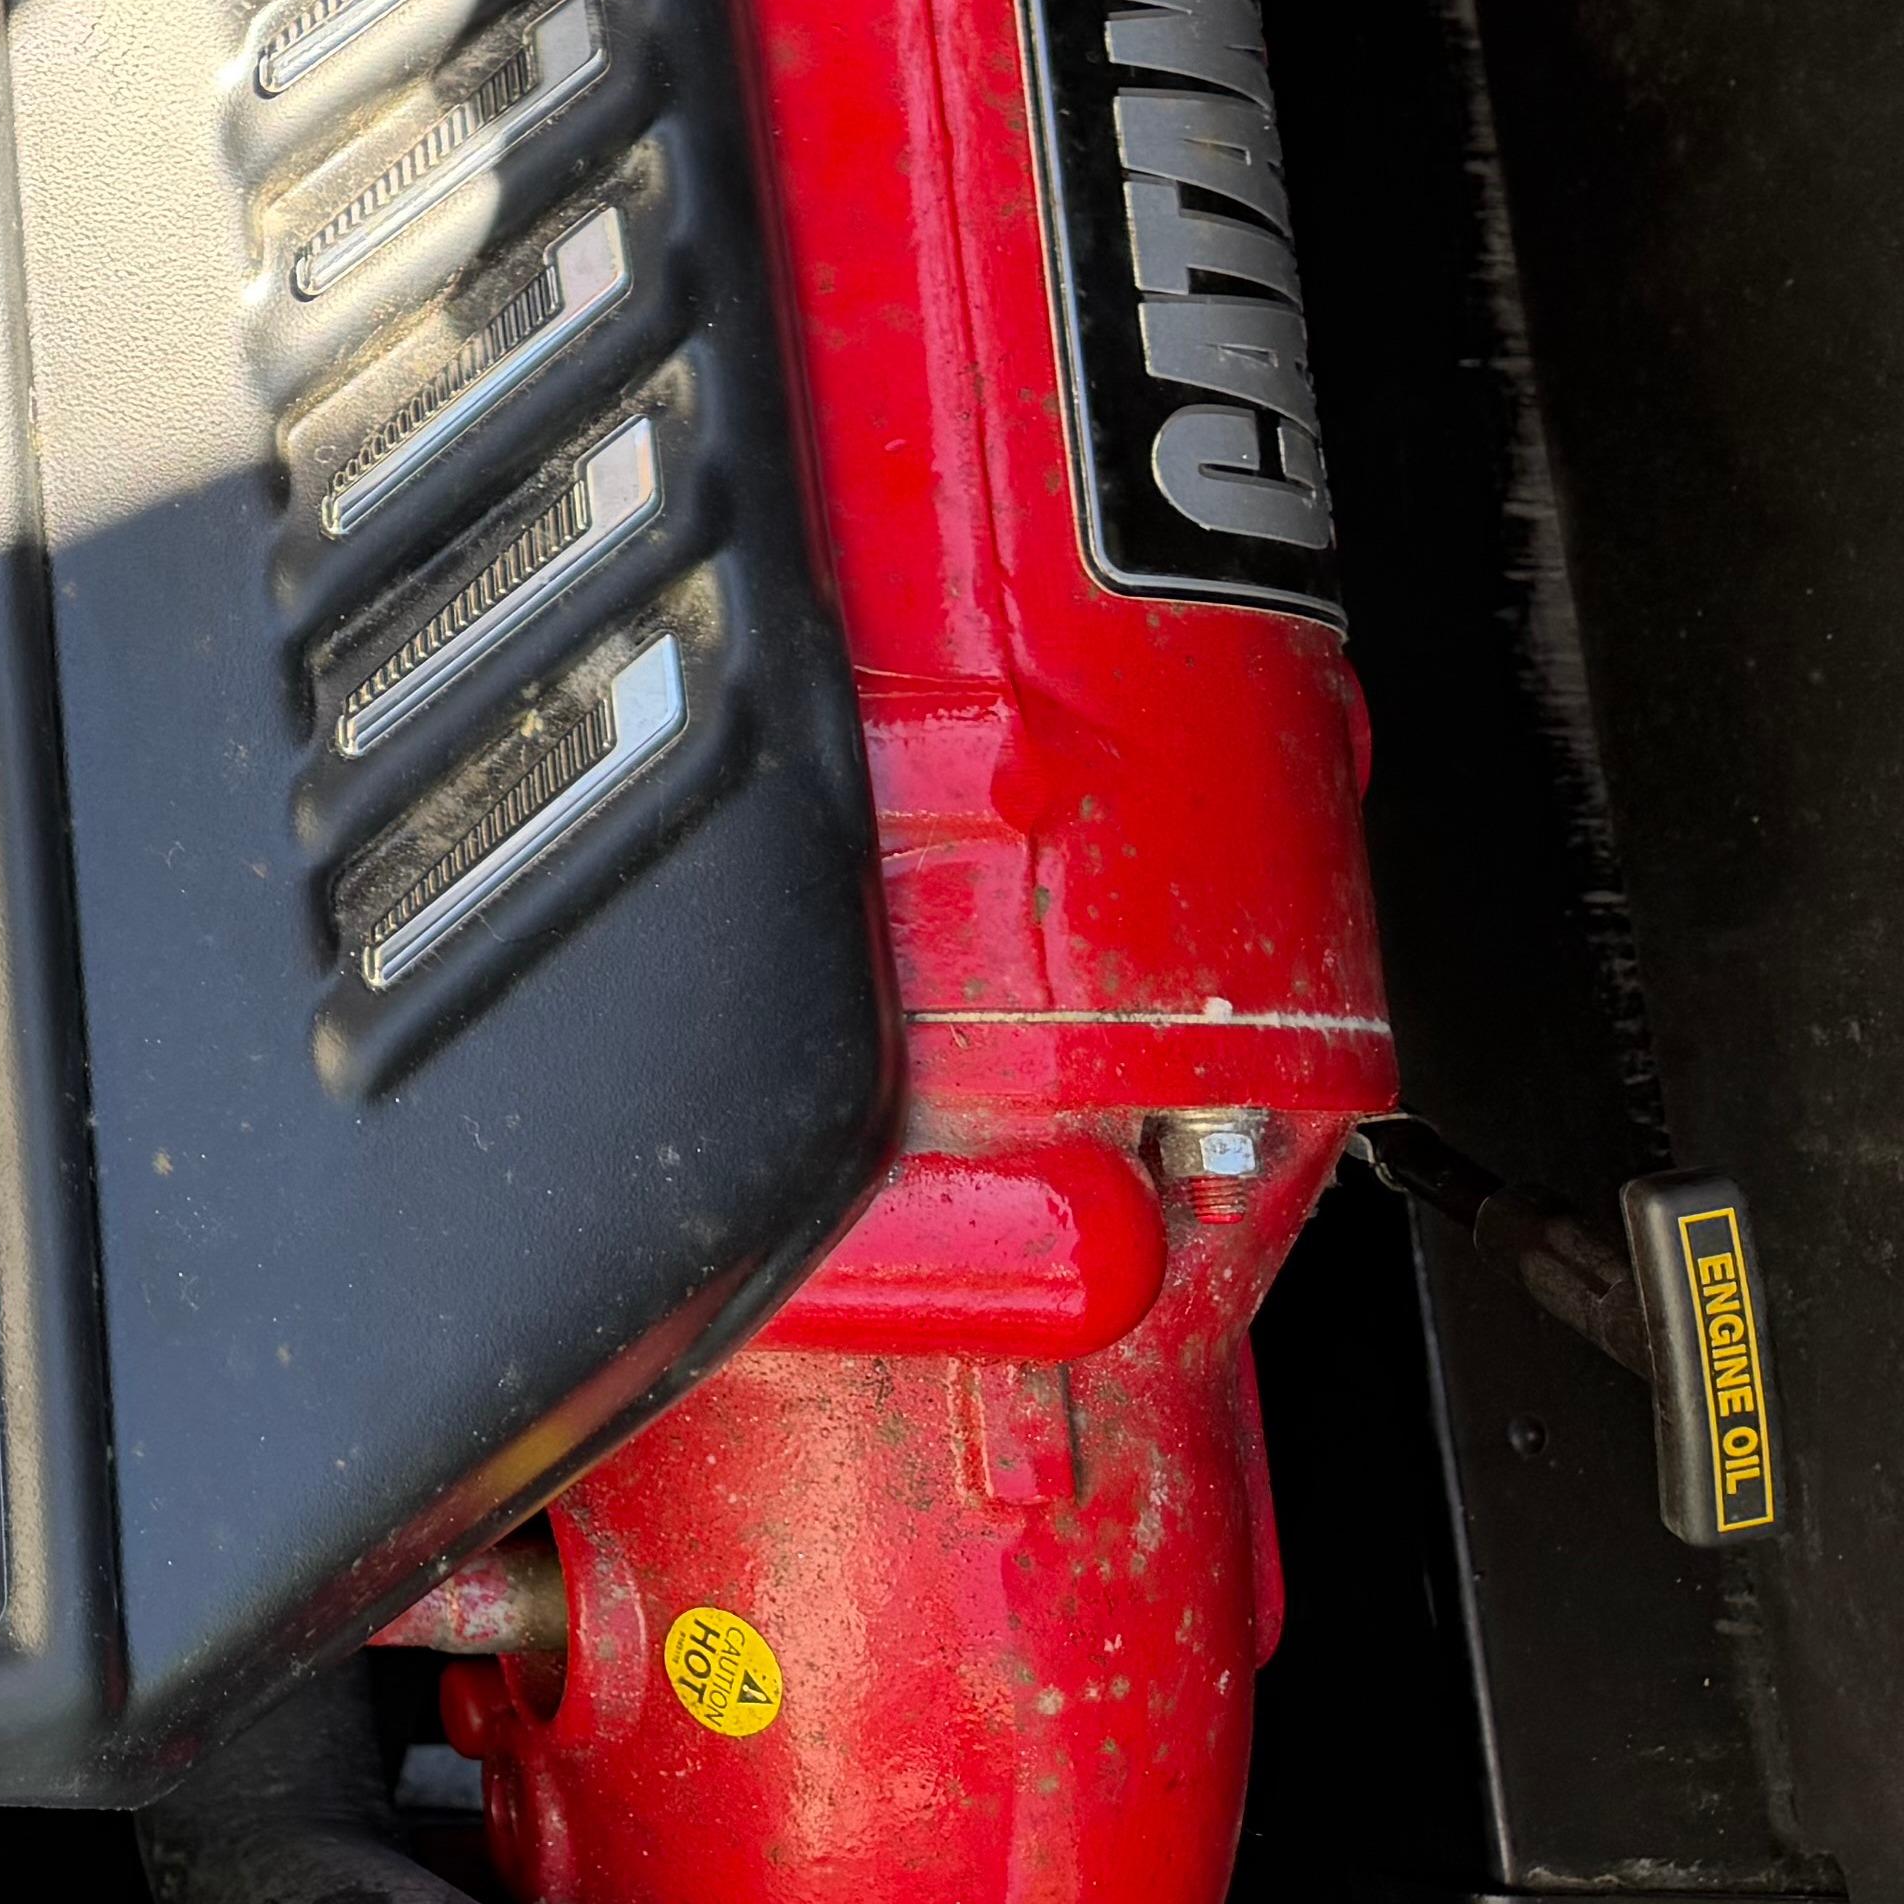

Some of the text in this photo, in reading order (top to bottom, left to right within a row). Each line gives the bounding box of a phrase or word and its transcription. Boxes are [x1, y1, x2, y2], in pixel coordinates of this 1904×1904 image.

[1697, 1252, 1762, 1497] ENGINE OIL
[676, 1617, 721, 1705] HOT
[702, 1625, 746, 1728] CAUTION
